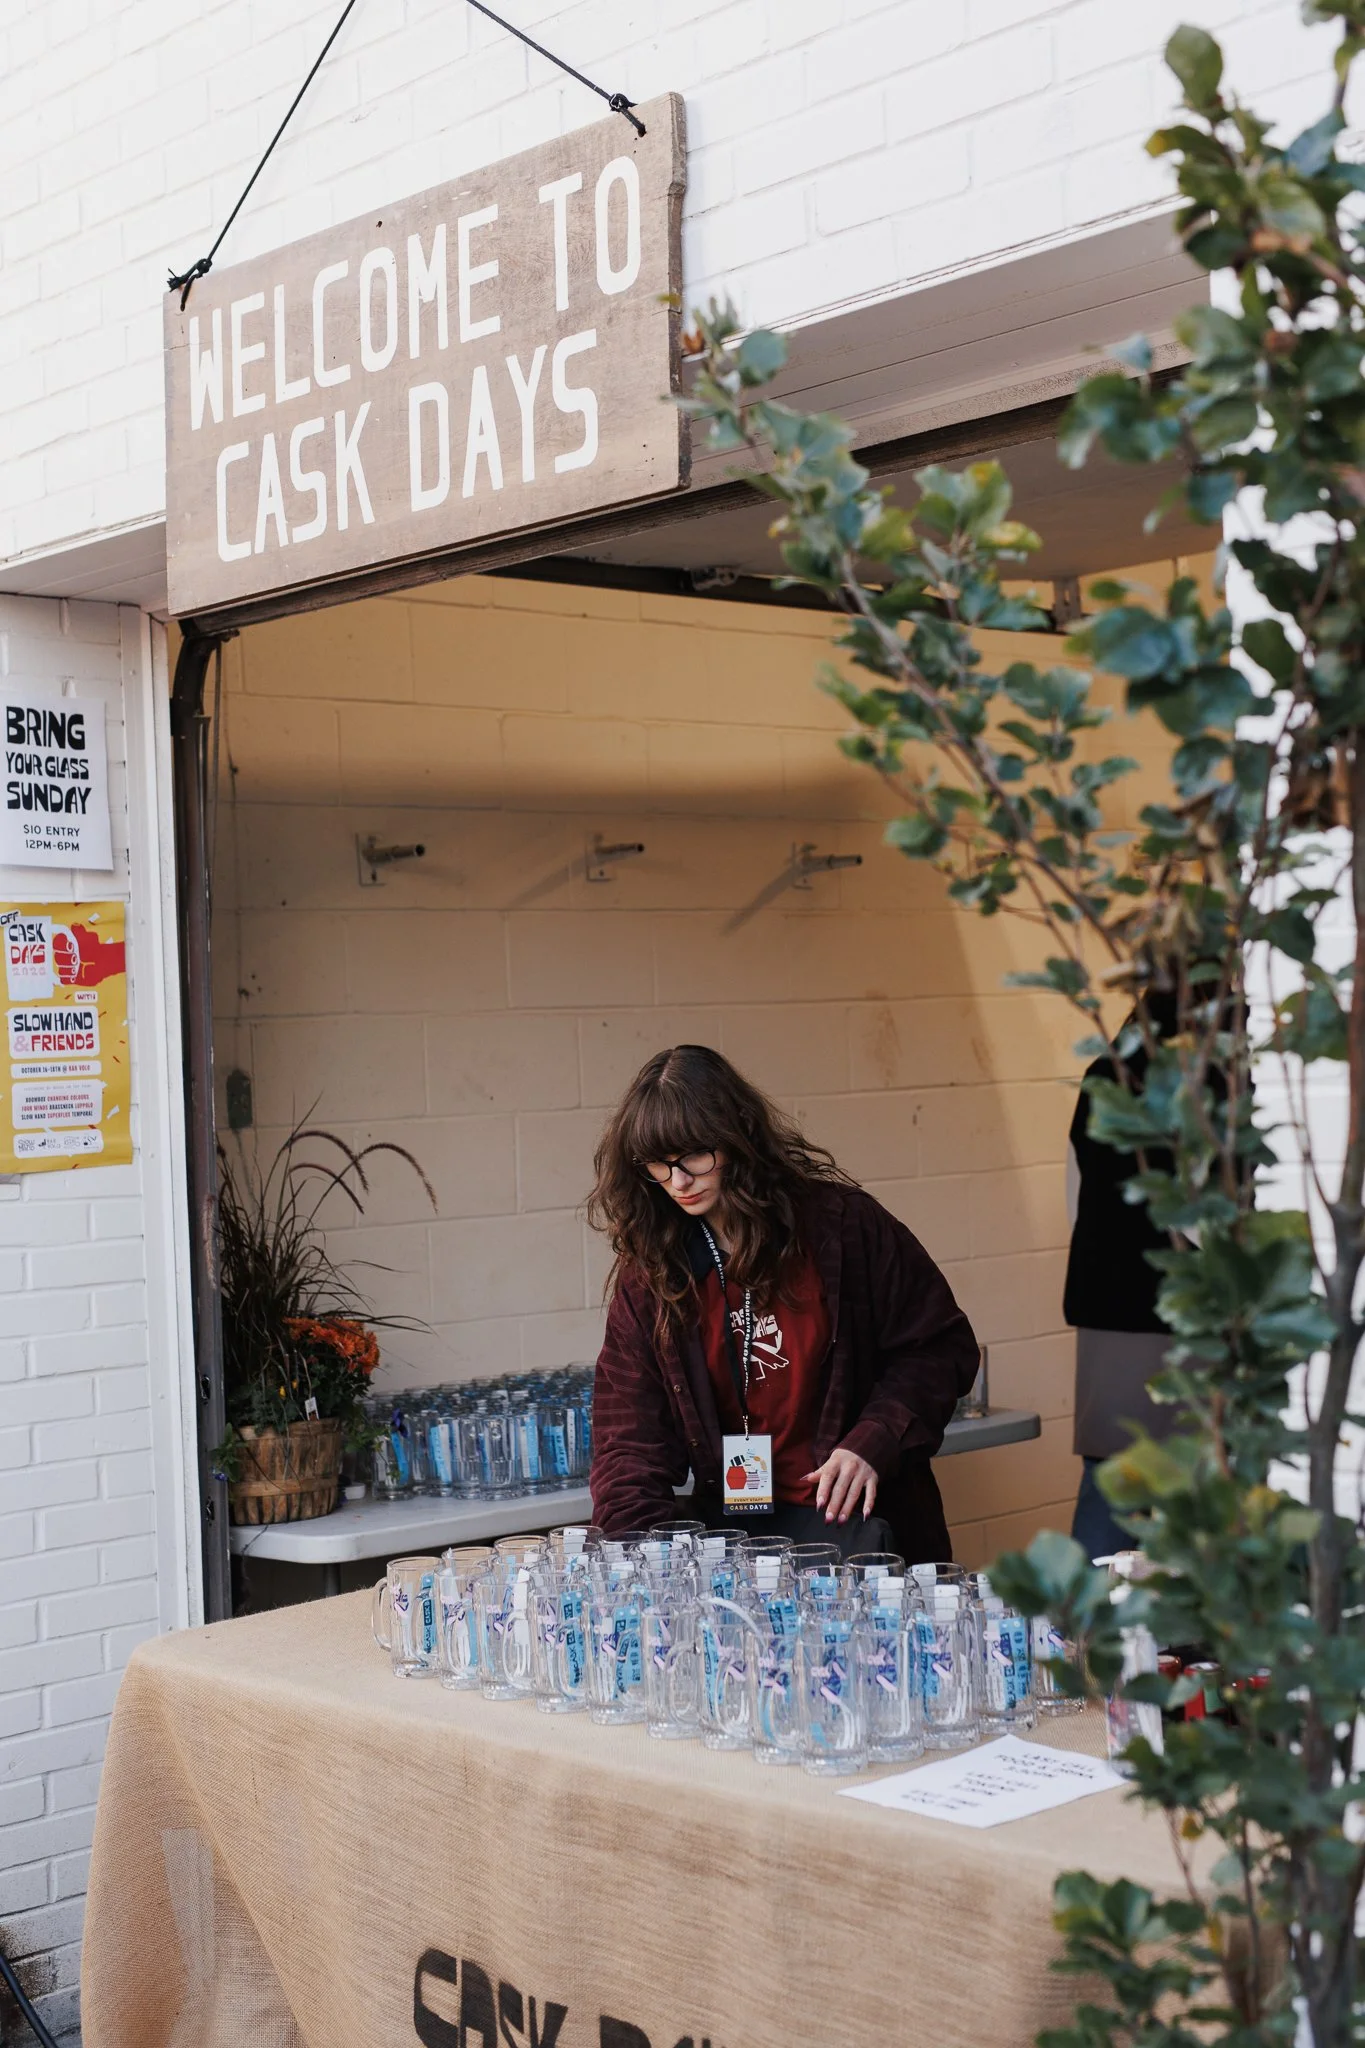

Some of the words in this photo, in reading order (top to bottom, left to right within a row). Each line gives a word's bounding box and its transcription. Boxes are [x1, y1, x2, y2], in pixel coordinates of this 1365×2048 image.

[189, 203, 502, 432] WELCOME
[538, 155, 642, 312] TO
[216, 400, 376, 563] CASK
[408, 328, 599, 513] DAYS
[6, 705, 86, 751] BRING
[5, 751, 43, 776] YOUR
[44, 755, 90, 780] GLASS
[6, 780, 92, 815] SUNDAY
[45, 825, 81, 837] ENTRY
[25, 839, 80, 852] 12PM-6PM
[8, 922, 46, 943] CASK
[10, 944, 46, 965] DAYS
[77, 993, 96, 1001] WITH
[13, 1035, 30, 1052] &
[31, 1033, 95, 1052] FRIENDS
[21, 1066, 42, 1074] OCTOBER
[751, 1313, 780, 1340] AYS
